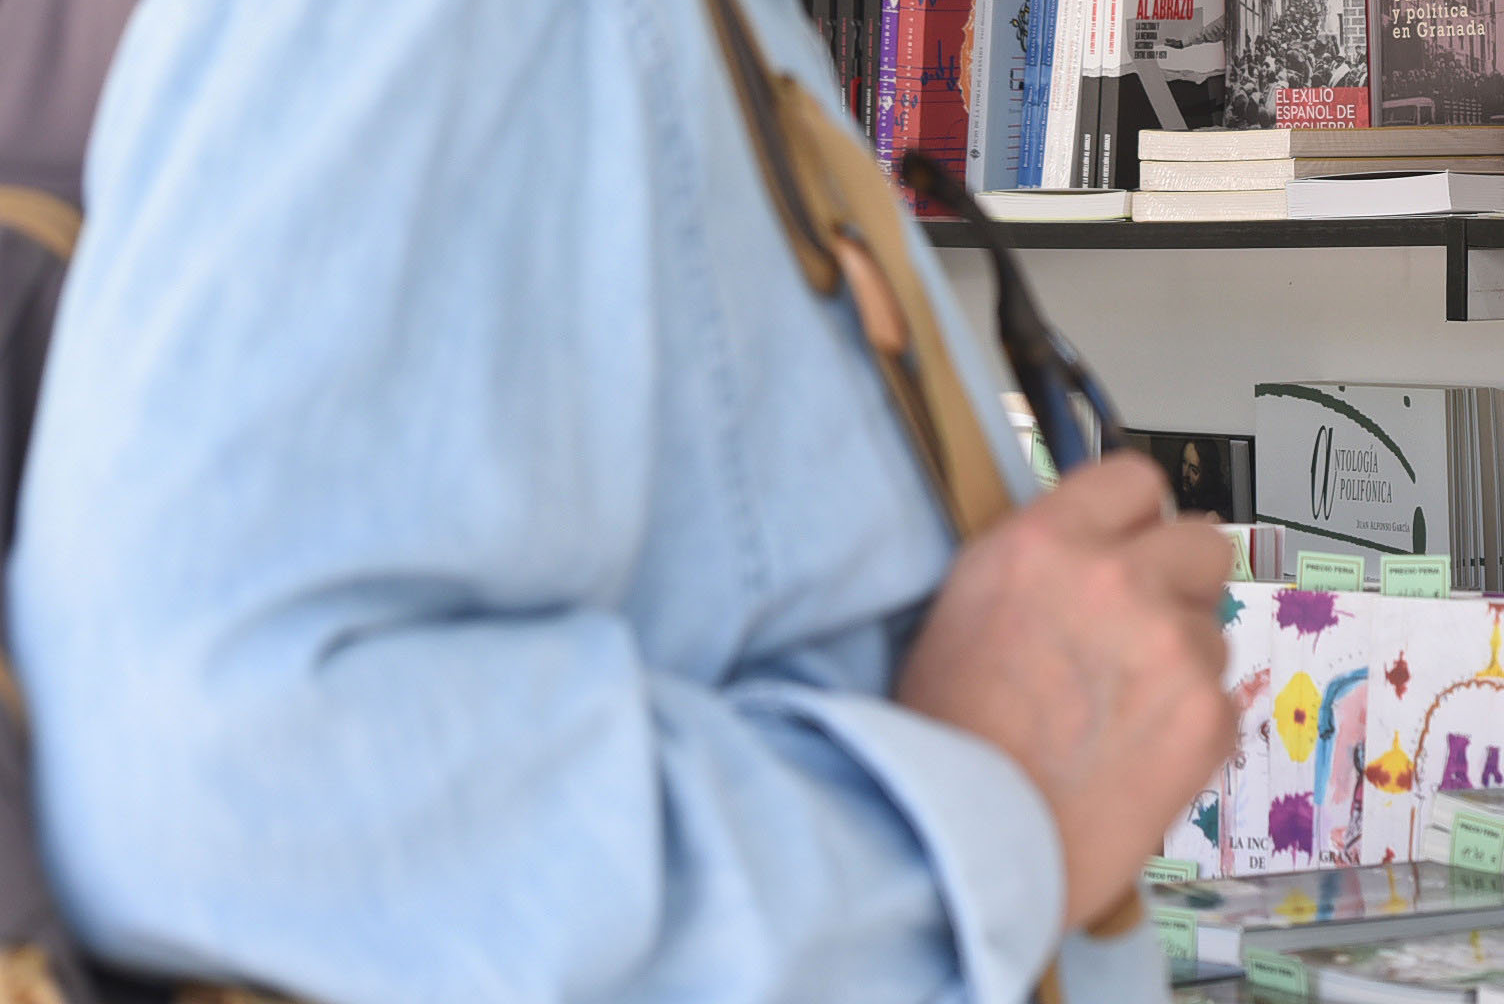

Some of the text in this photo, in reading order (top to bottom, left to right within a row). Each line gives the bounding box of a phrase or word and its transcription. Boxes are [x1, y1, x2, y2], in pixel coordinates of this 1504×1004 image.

[1392, 2, 1469, 24] y política
[1392, 19, 1486, 38] en Granada
[1275, 88, 1334, 103] EL EXILIO
[1275, 101, 1355, 120] ESPAÑOL DE
[1340, 474, 1393, 504] POLIFÓNICA
[1249, 856, 1266, 869] DE
